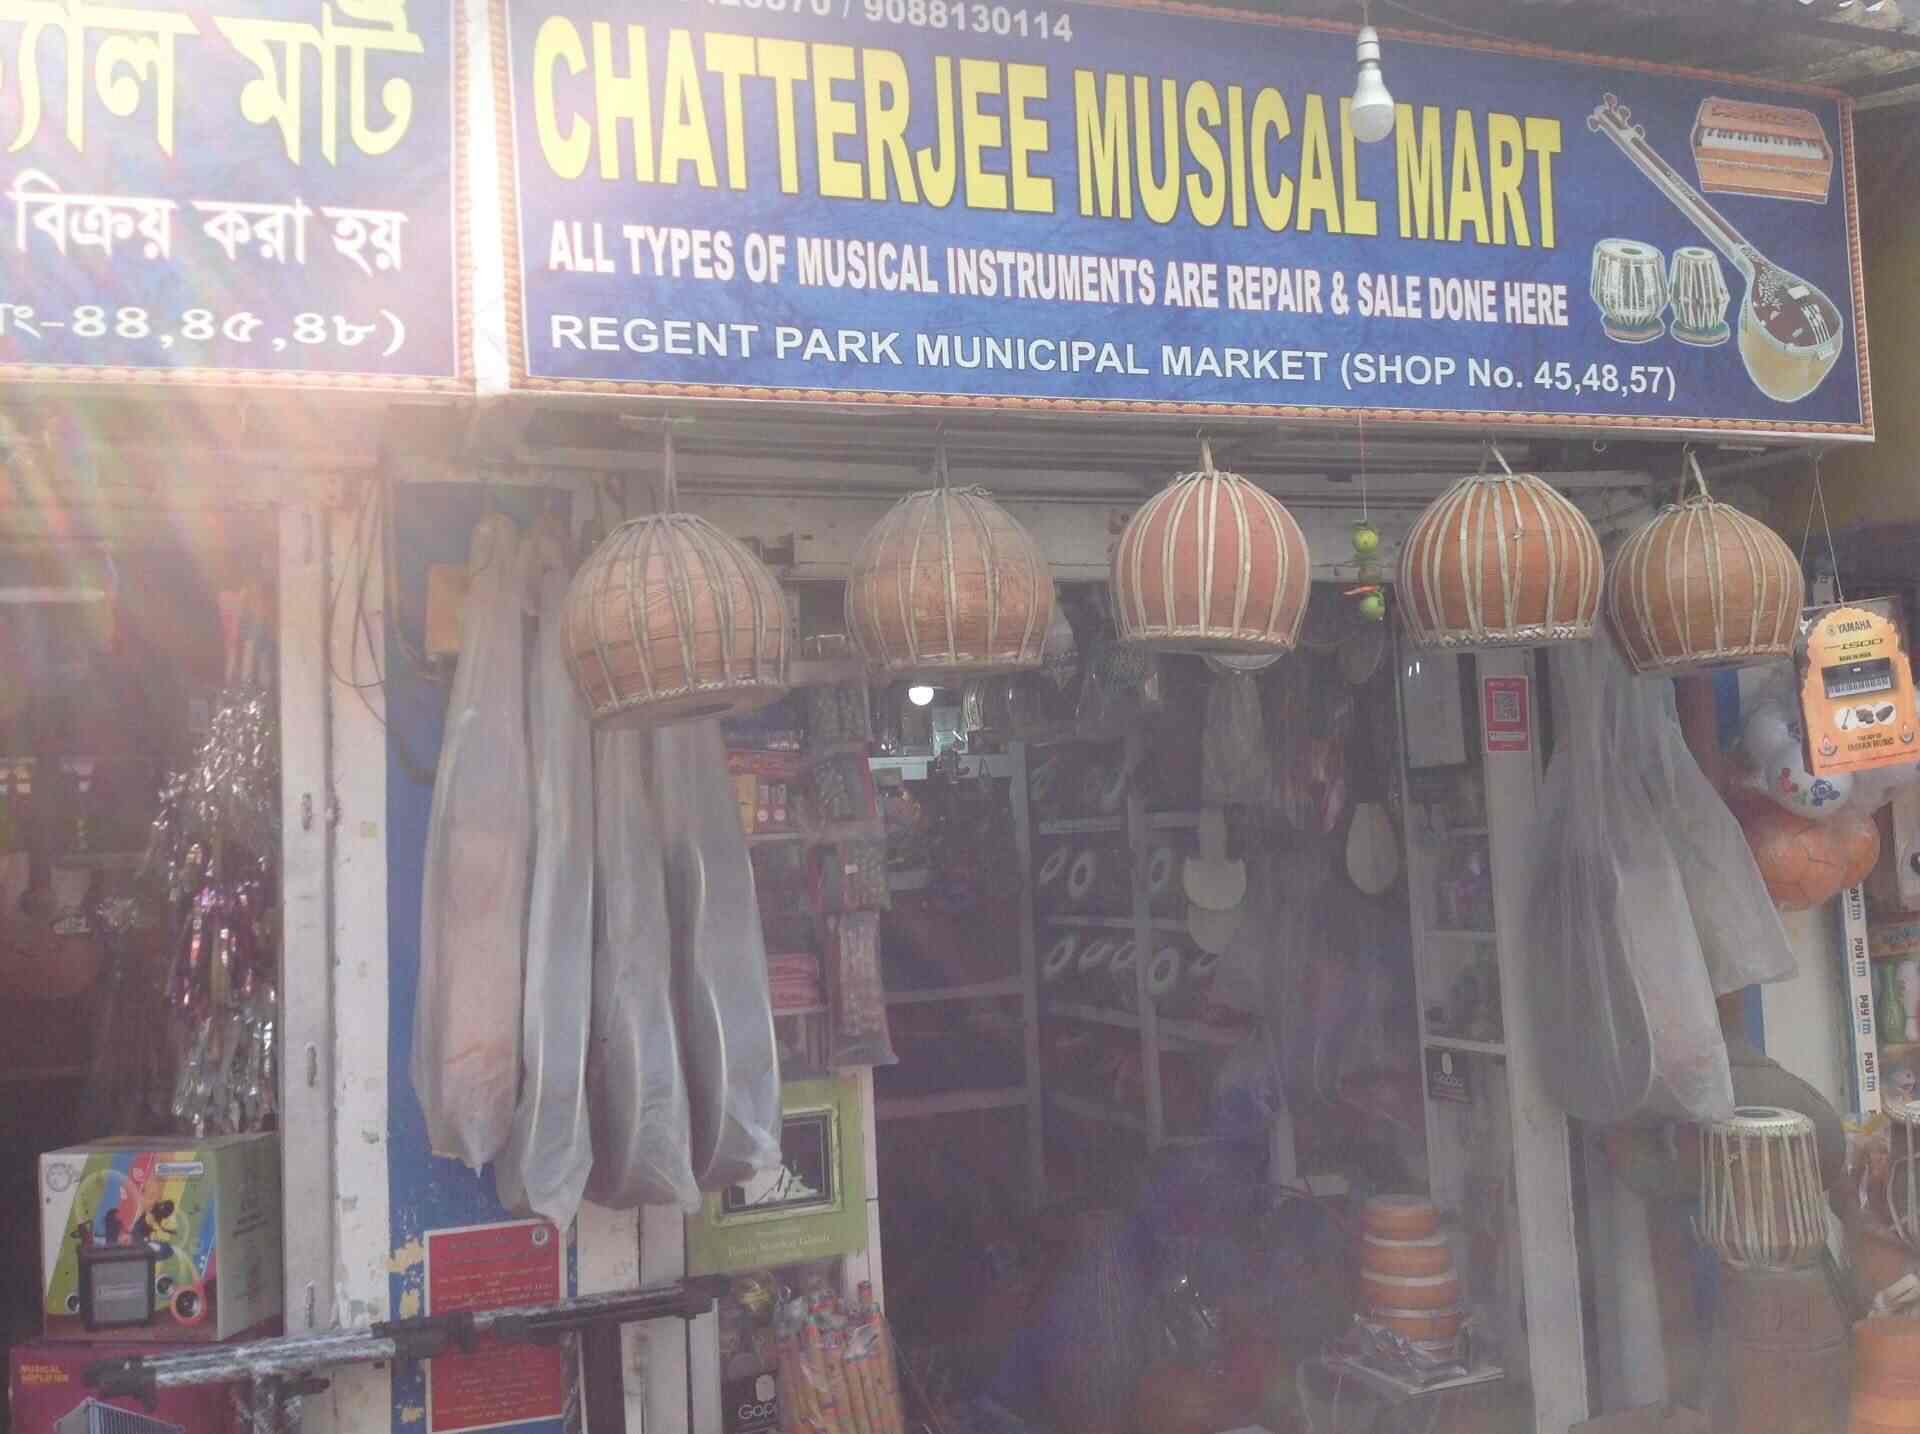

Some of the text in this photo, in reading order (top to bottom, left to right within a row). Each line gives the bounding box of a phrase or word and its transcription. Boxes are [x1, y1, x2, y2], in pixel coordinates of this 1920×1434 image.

[863, 0, 1073, 43] 9088130114
[533, 15, 1561, 248] CHATTERJEE MUSICAL MART
[5, 168, 408, 278] বিক্রয় করা হয়
[549, 221, 1569, 326] ALL TYPES OF MUSICAL INSTRUMENTS ARE REPAIR & SALE DONE HERE
[551, 315, 1676, 400] REGENT PARK MUNICIPAL MARKET (SHOP No. 45,48,57)
[1838, 619, 1873, 633] YAMAHA
[1850, 888, 1862, 920] aytm
